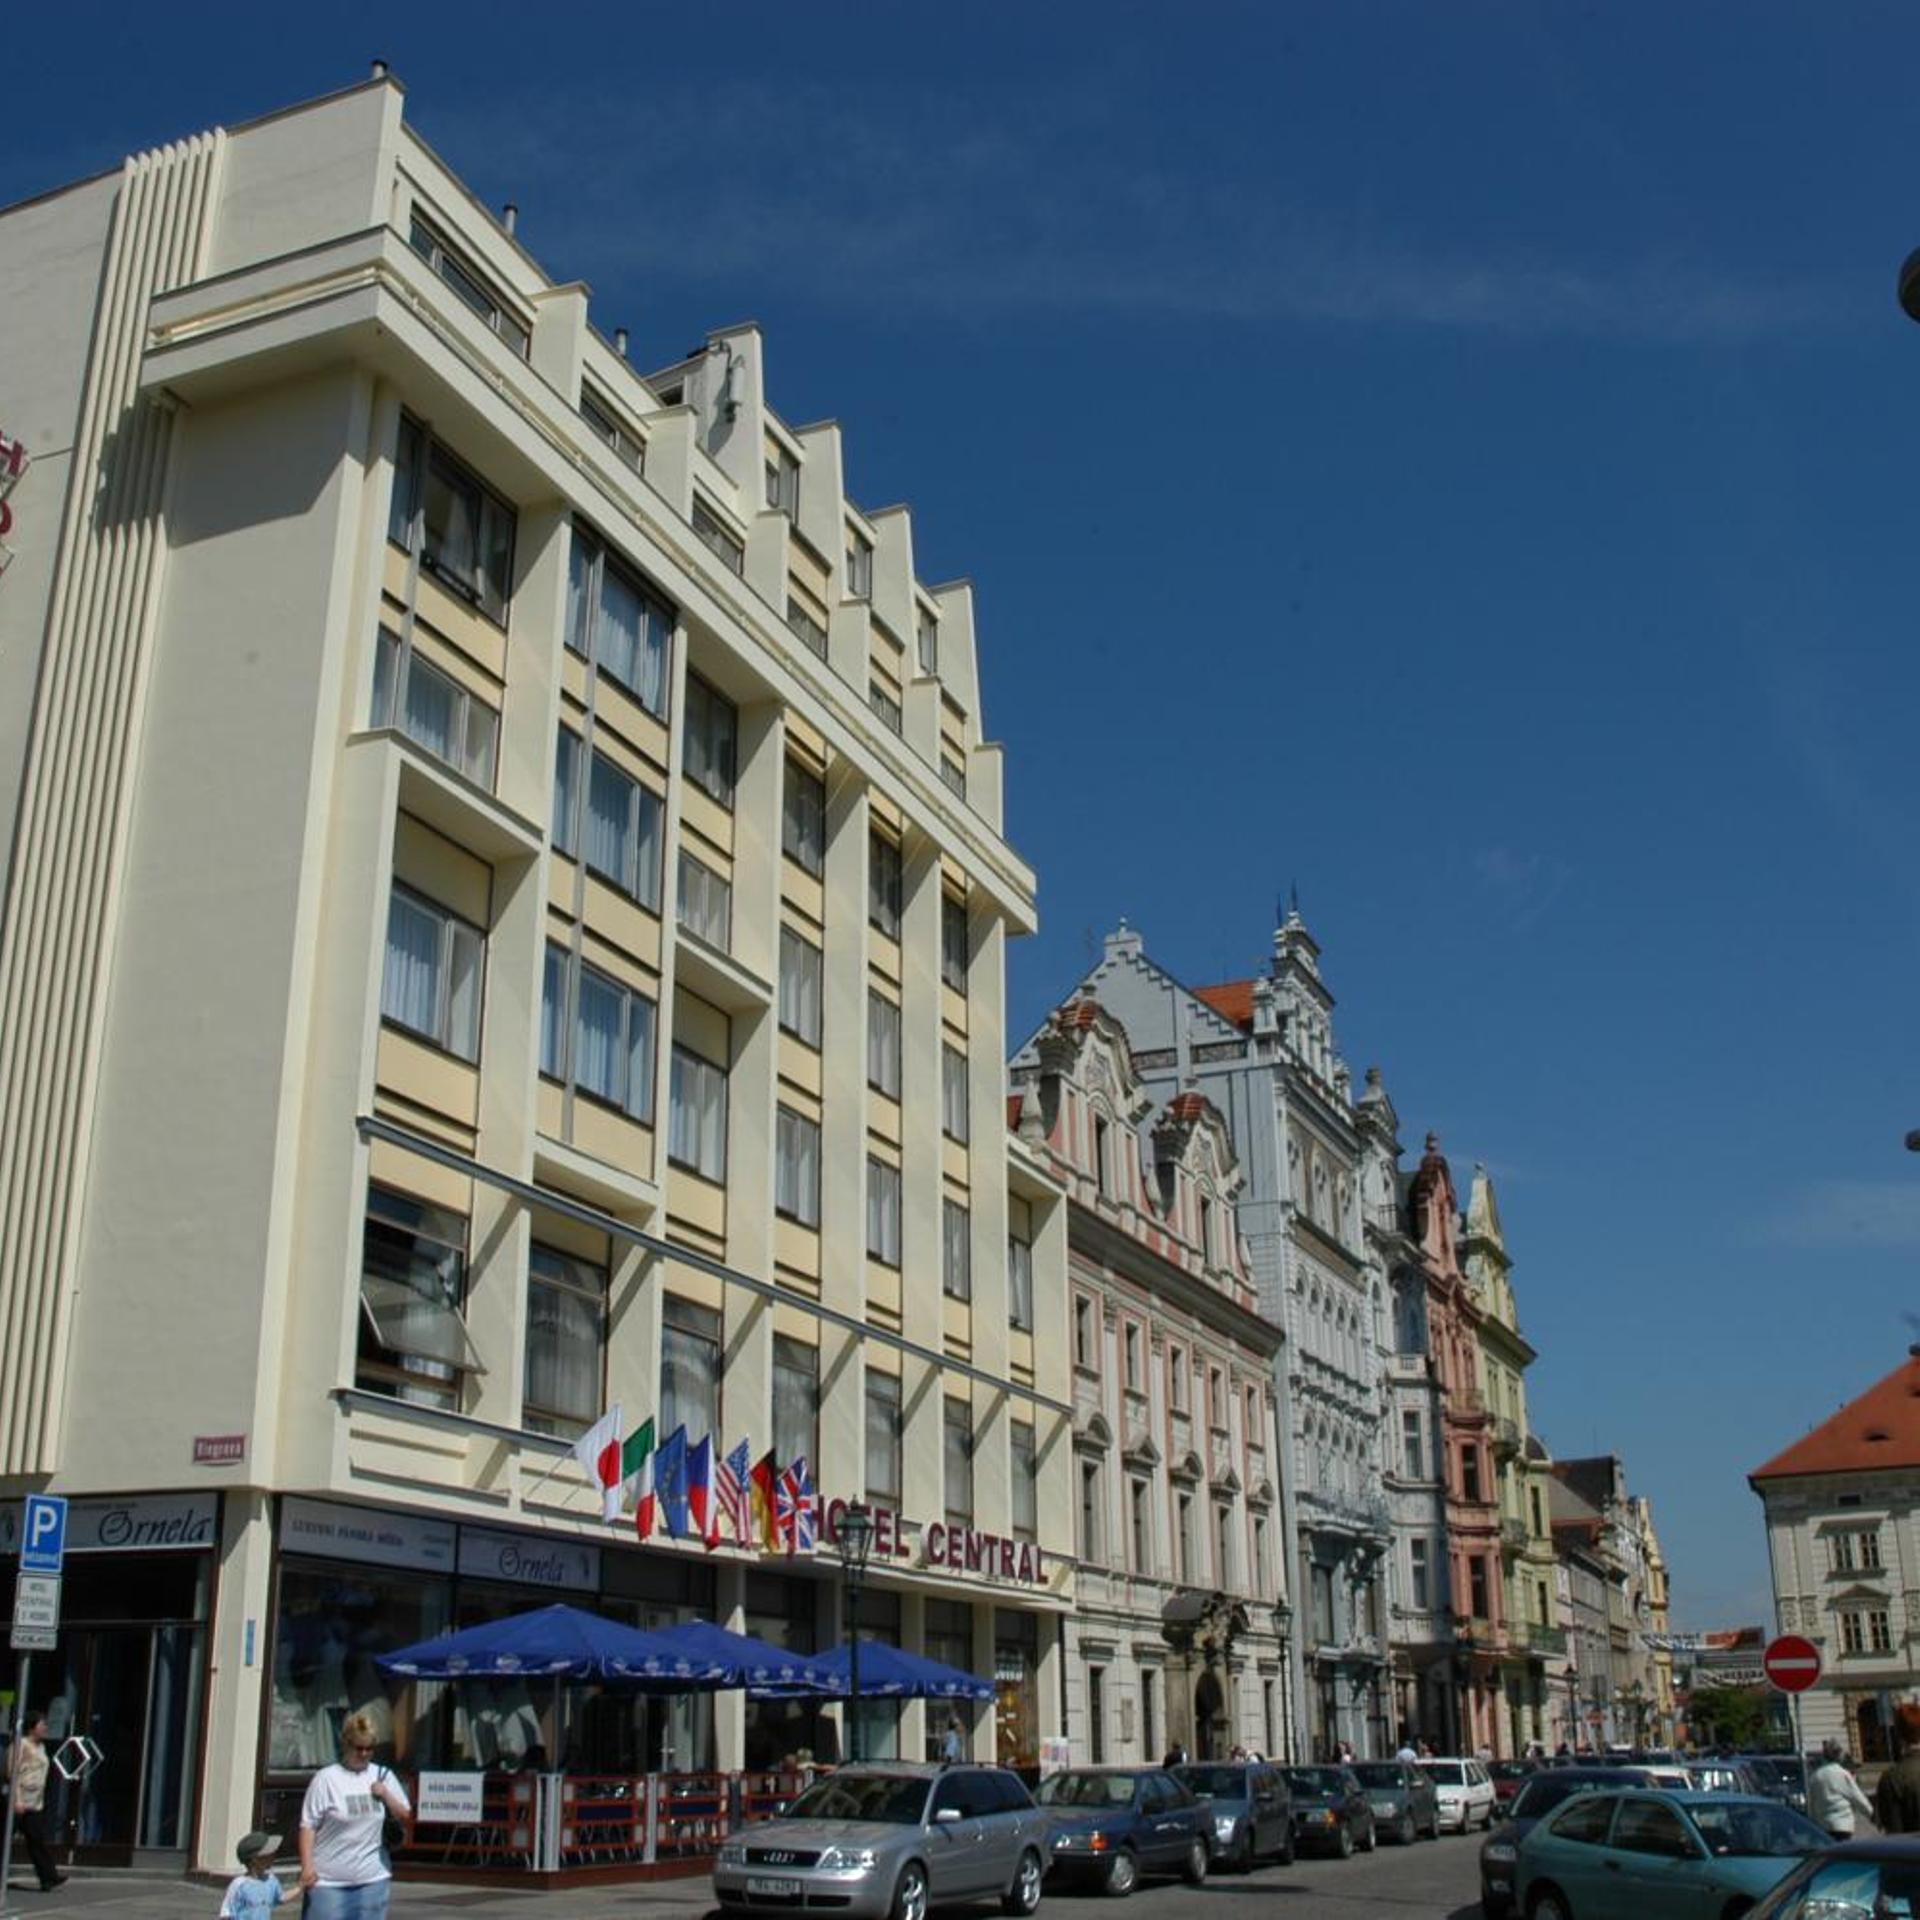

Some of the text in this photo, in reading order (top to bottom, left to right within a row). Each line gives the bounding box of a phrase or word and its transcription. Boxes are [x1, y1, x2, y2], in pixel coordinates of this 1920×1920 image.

[32, 1504, 58, 1547] P
[812, 1495, 1049, 1585] HOEL CENTRAL
